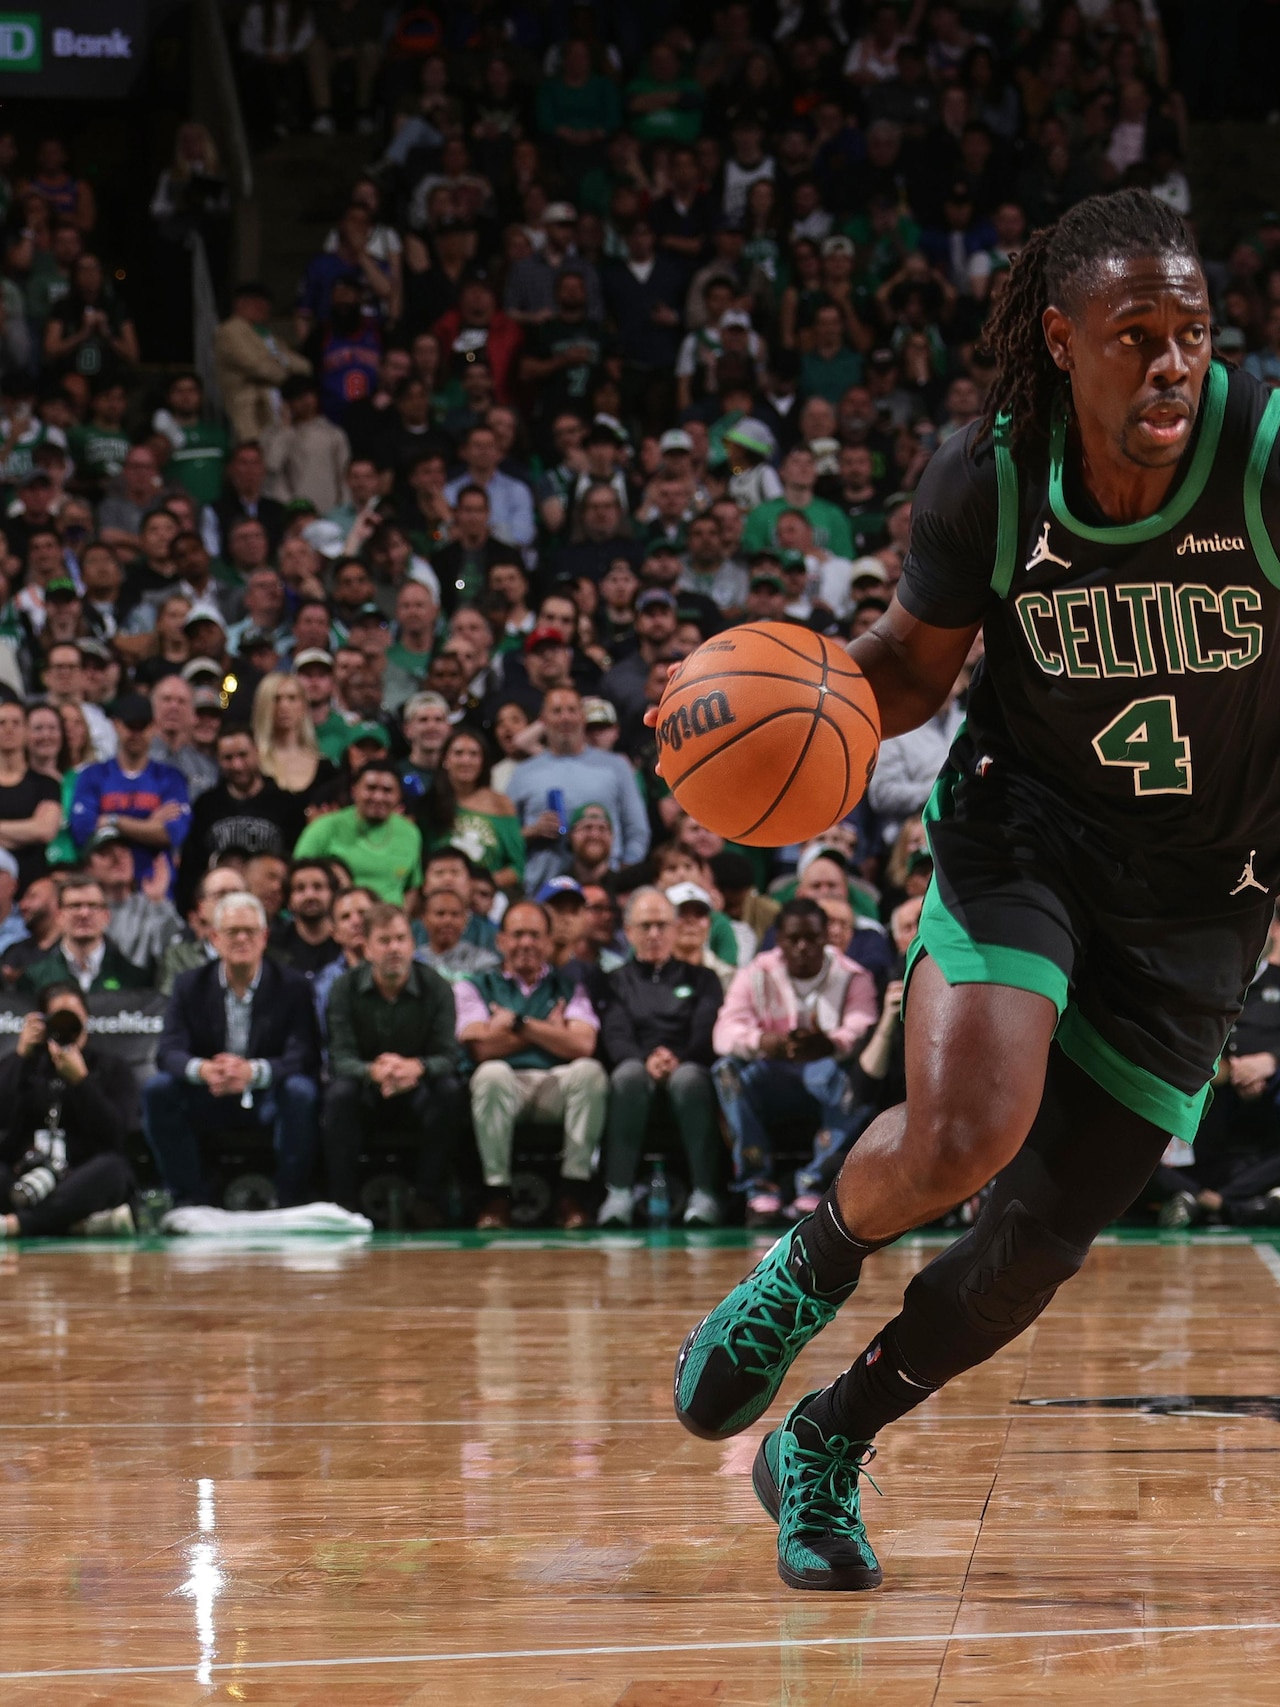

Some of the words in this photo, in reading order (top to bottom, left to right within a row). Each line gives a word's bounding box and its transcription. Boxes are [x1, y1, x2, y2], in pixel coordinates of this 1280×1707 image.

[52, 28, 132, 58] Bank
[1176, 532, 1245, 555] Amica
[1015, 582, 1263, 679] CELTICS
[1091, 694, 1193, 797] 4
